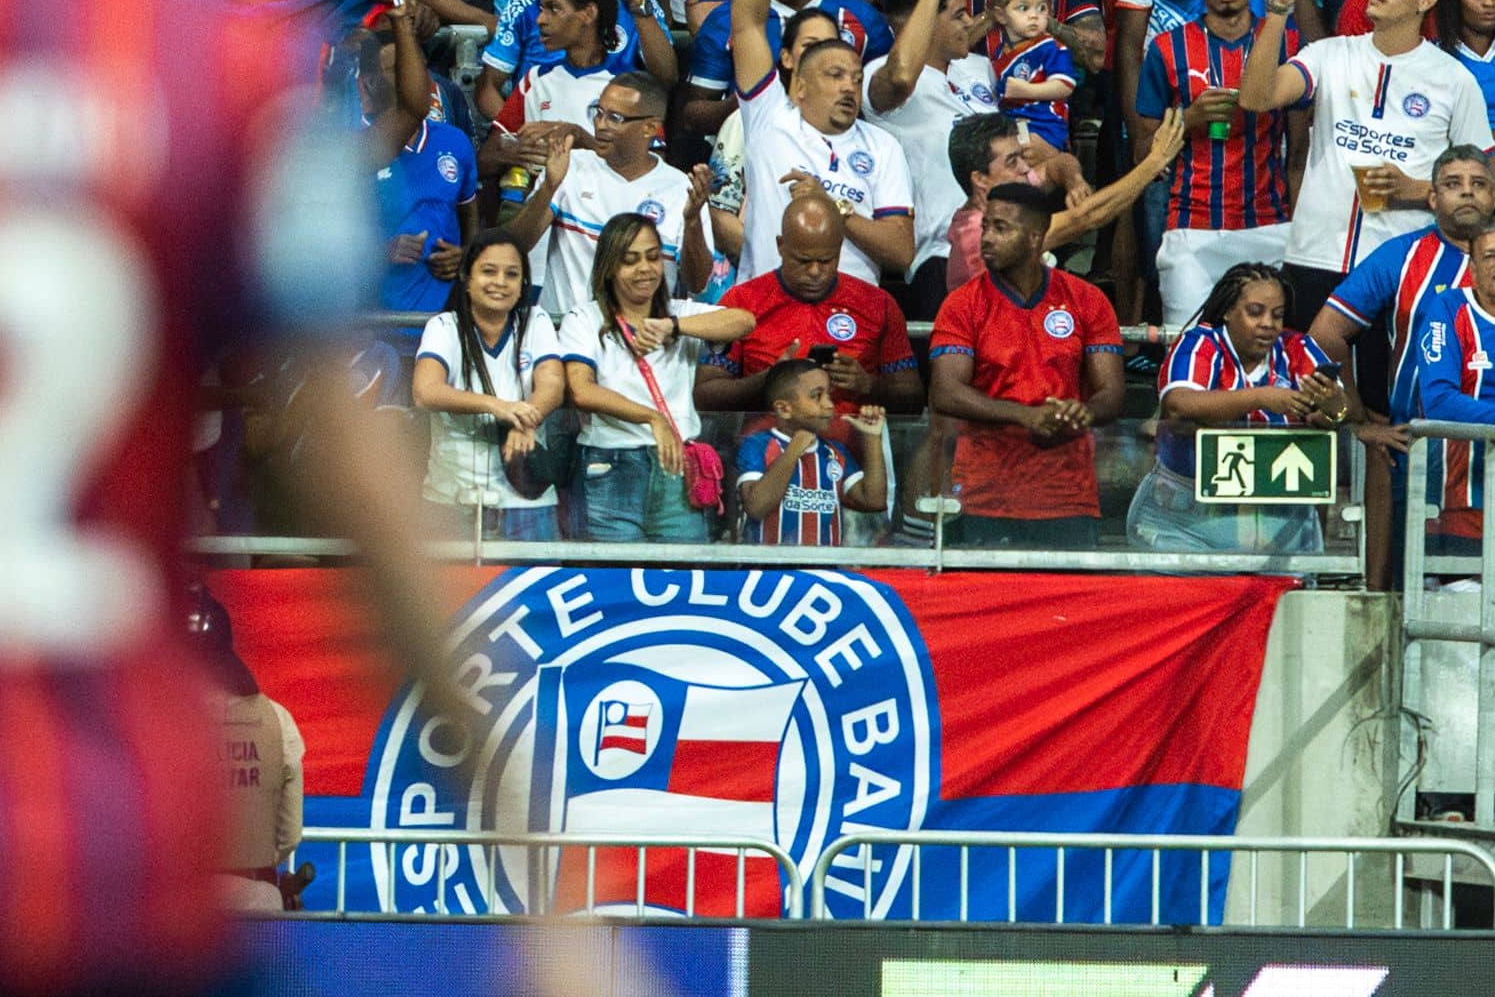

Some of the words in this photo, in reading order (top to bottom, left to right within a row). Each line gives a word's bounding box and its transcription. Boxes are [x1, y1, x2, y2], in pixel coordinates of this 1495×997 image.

[1336, 120, 1415, 149] Esportes
[1336, 135, 1359, 151] da
[1360, 139, 1408, 162] Sorte
[630, 568, 882, 688] CLUBE
[824, 698, 900, 915] BAHI
